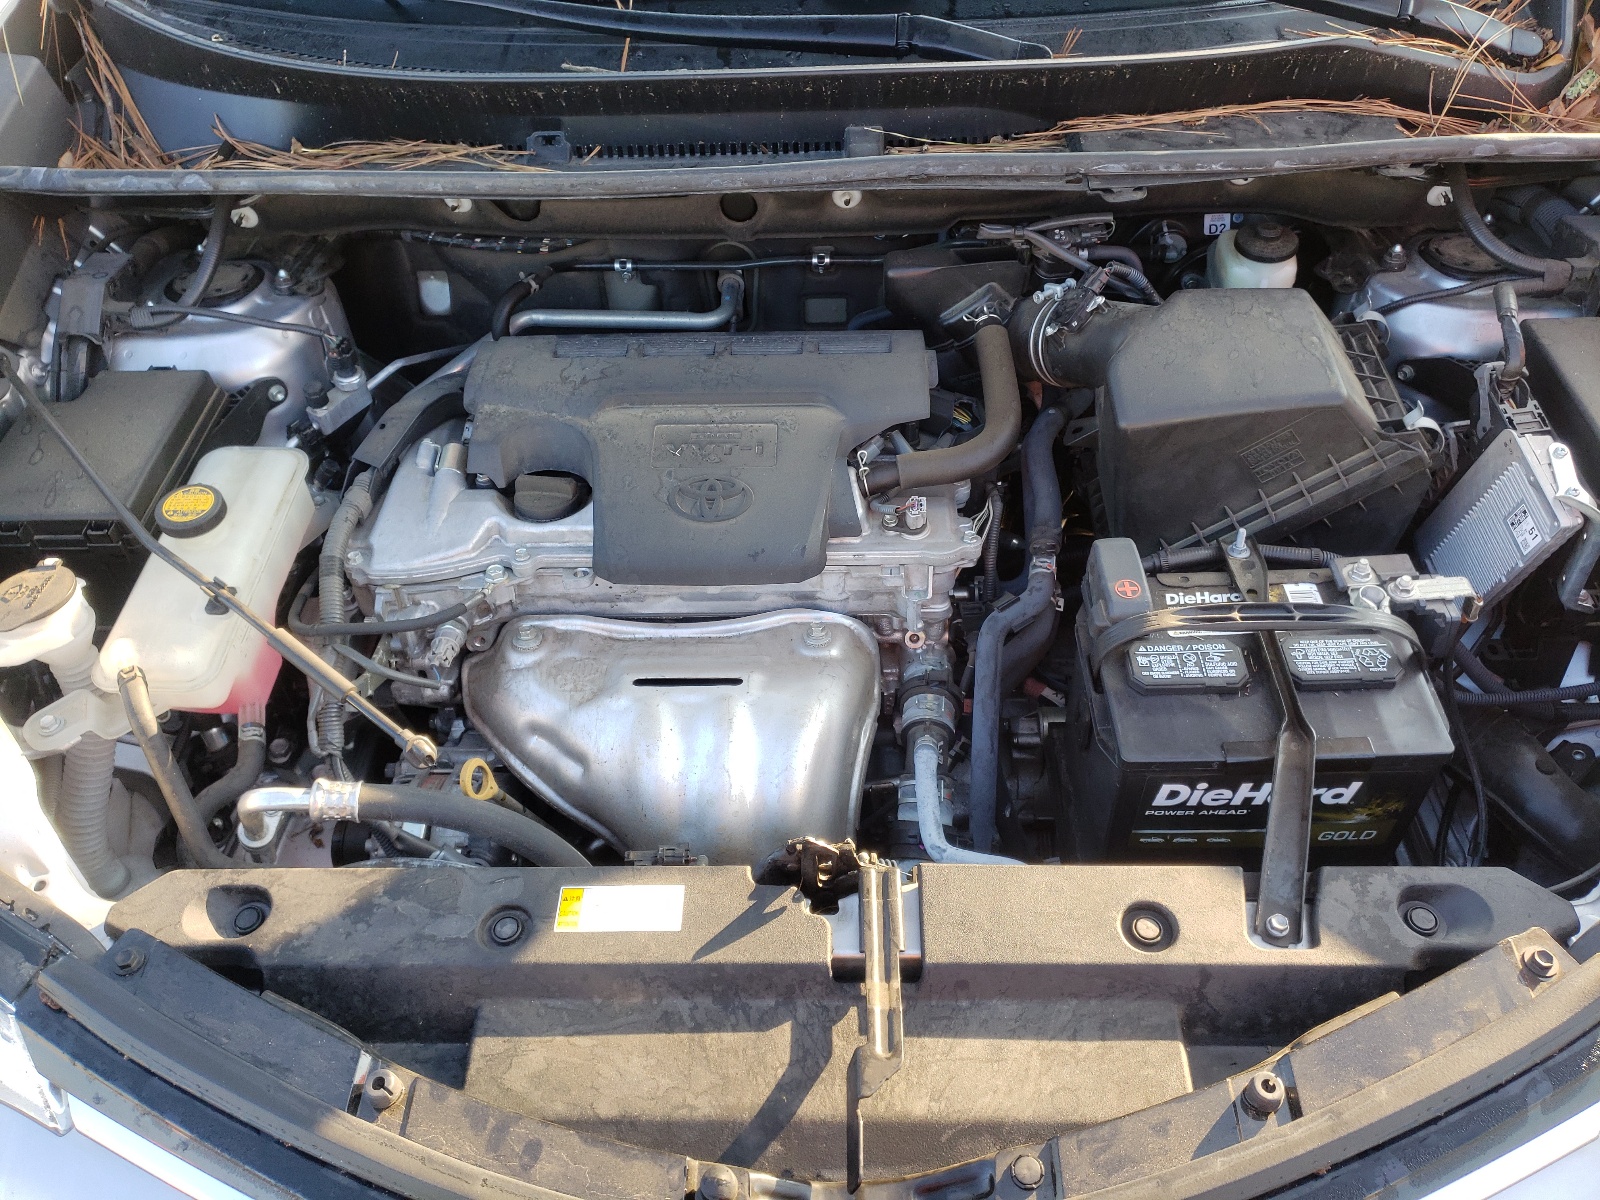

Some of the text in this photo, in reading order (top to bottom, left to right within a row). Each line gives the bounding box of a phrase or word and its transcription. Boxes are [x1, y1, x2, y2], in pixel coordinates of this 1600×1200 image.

[1209, 223, 1226, 235] D2
[1147, 644, 1183, 652] DANGER
[1192, 643, 1226, 651] POISON
[1151, 781, 1364, 807] DieHrd
[1317, 830, 1377, 841] GOLD
